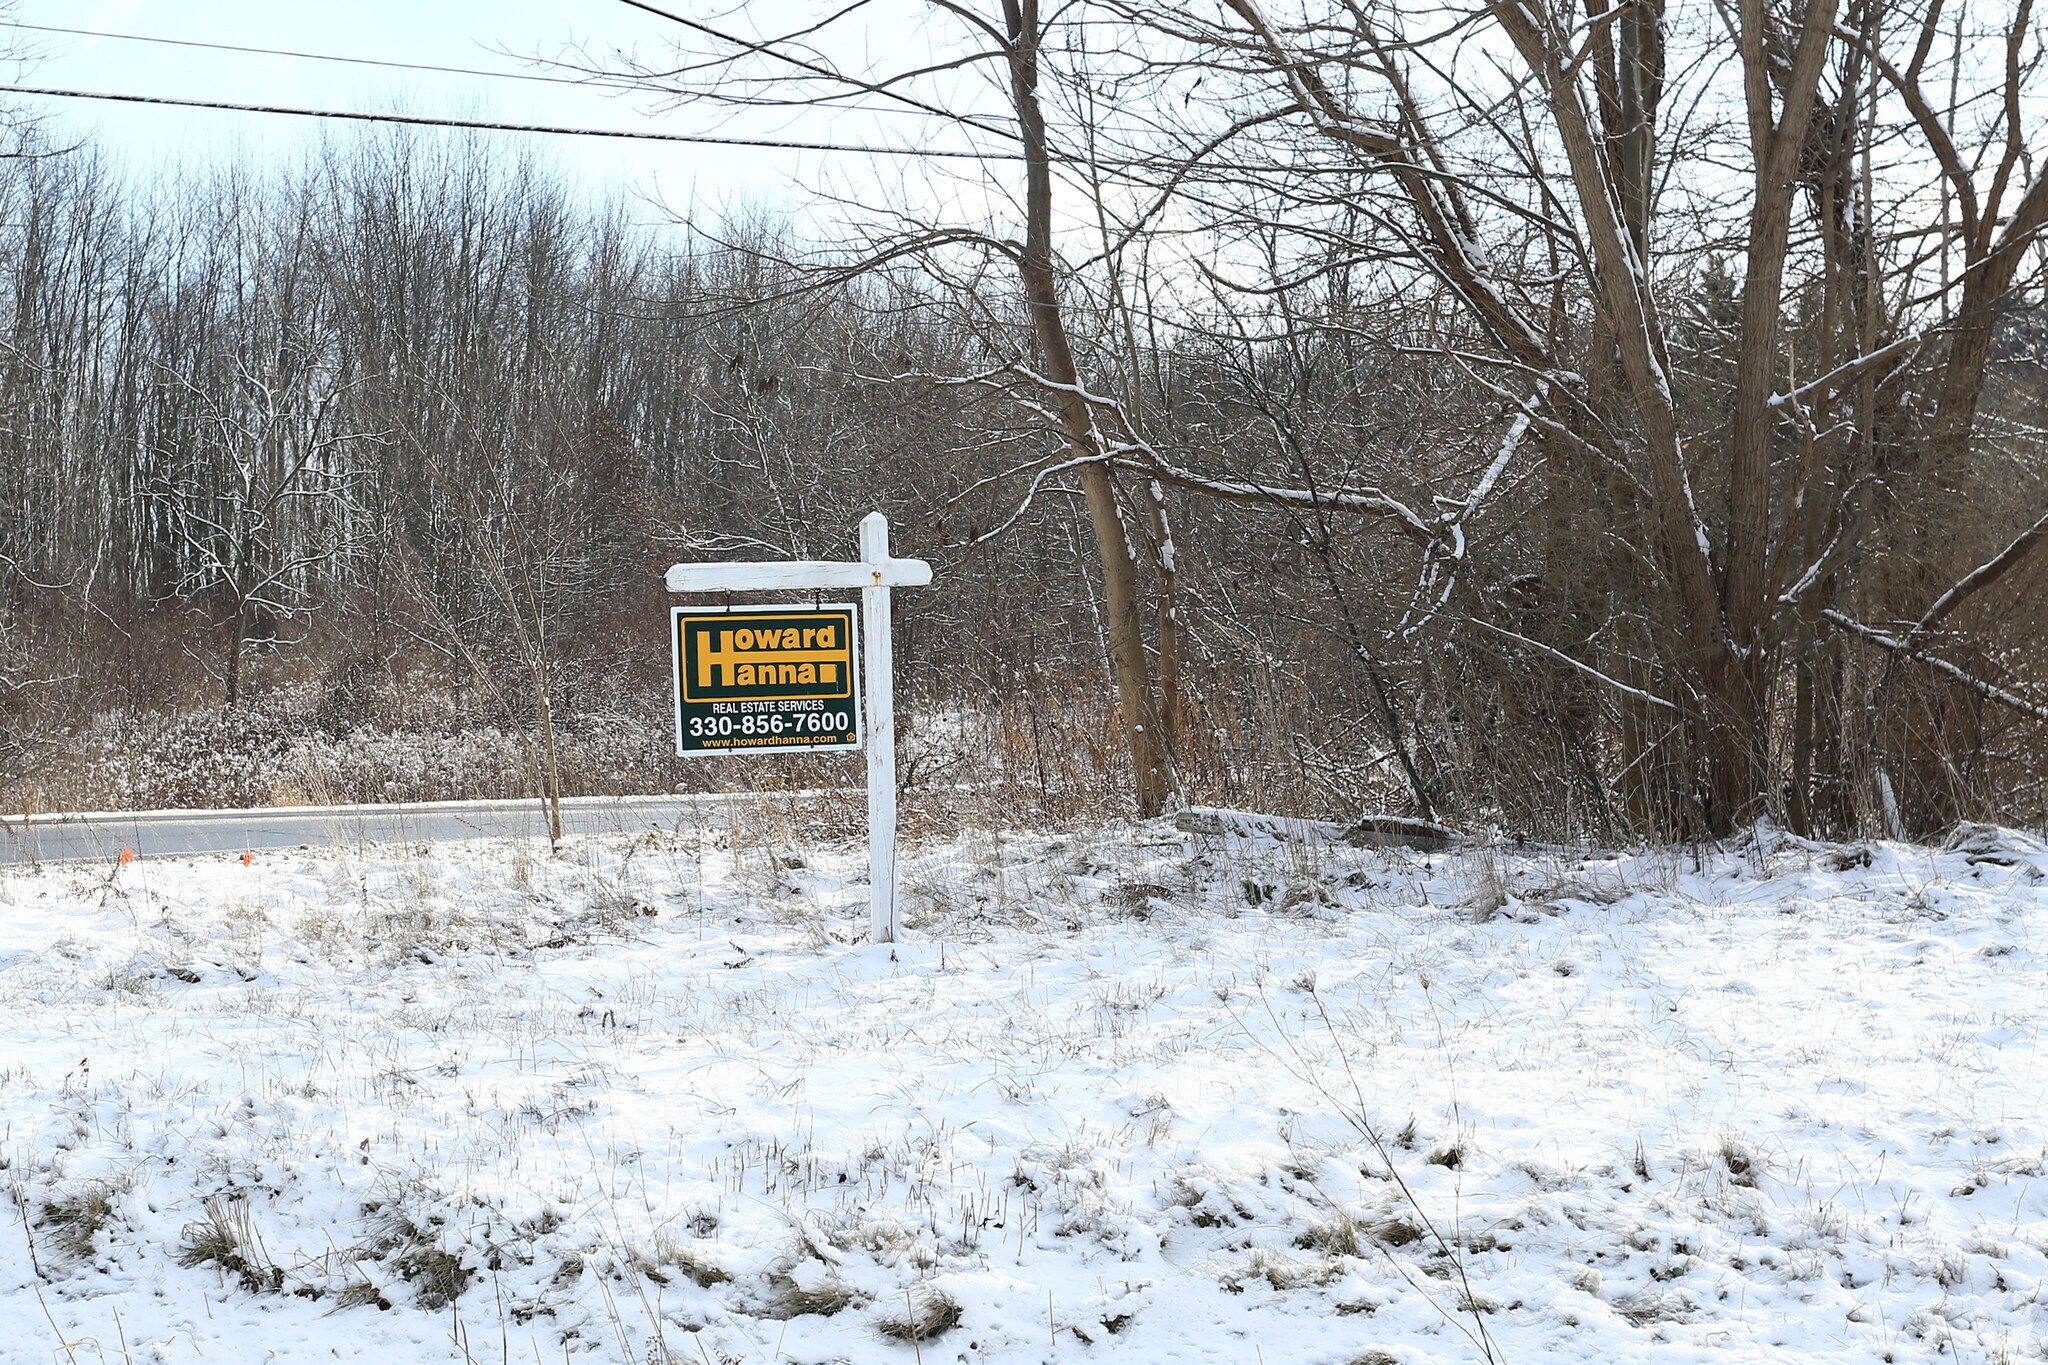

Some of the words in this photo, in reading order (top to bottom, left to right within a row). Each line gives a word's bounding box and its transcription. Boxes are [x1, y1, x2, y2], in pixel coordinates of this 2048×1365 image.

[697, 625, 836, 664] Howard
[697, 649, 818, 687] Hanna
[713, 703, 738, 714] REAL
[741, 701, 775, 712] ESTATE
[778, 700, 824, 711] SERVICES
[690, 712, 848, 736] 330-856-7600
[702, 735, 837, 747] www.howardhanna.com
